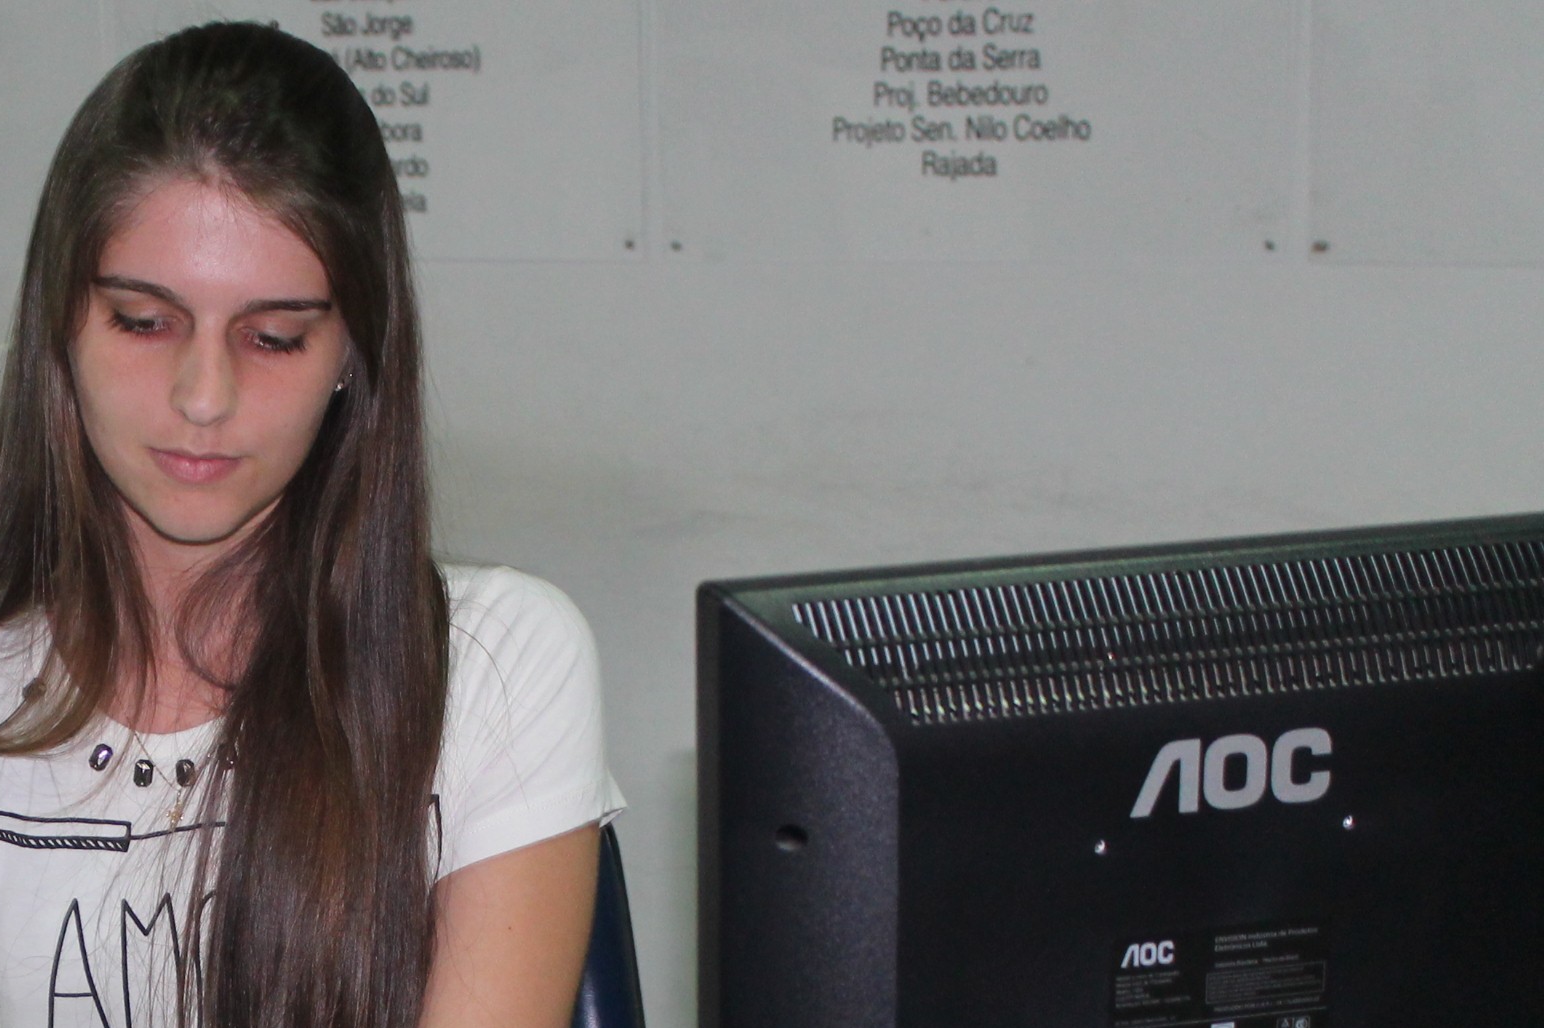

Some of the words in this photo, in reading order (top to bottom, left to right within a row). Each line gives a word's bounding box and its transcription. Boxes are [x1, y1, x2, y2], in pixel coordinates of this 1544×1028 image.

[321, 12, 354, 37] São
[361, 13, 412, 40] Jorge
[887, 11, 942, 41] Poço
[948, 11, 976, 36] da
[983, 8, 1035, 35] Cruz
[392, 44, 481, 73] Cheiroso)
[881, 46, 942, 72] Ponta
[948, 47, 976, 71] da
[982, 43, 1041, 71] Serra
[372, 84, 395, 105] do
[400, 82, 430, 106] Sul
[874, 80, 919, 111] Proj.
[927, 80, 1049, 107] Bebedouro
[832, 115, 905, 148] Projeto
[911, 114, 956, 142] Sen.
[965, 114, 1007, 141] Nilo
[1013, 112, 1092, 141] Coelho
[921, 150, 998, 181] Rajada
[1129, 726, 1333, 819] AOC
[1120, 940, 1176, 969] AOC
